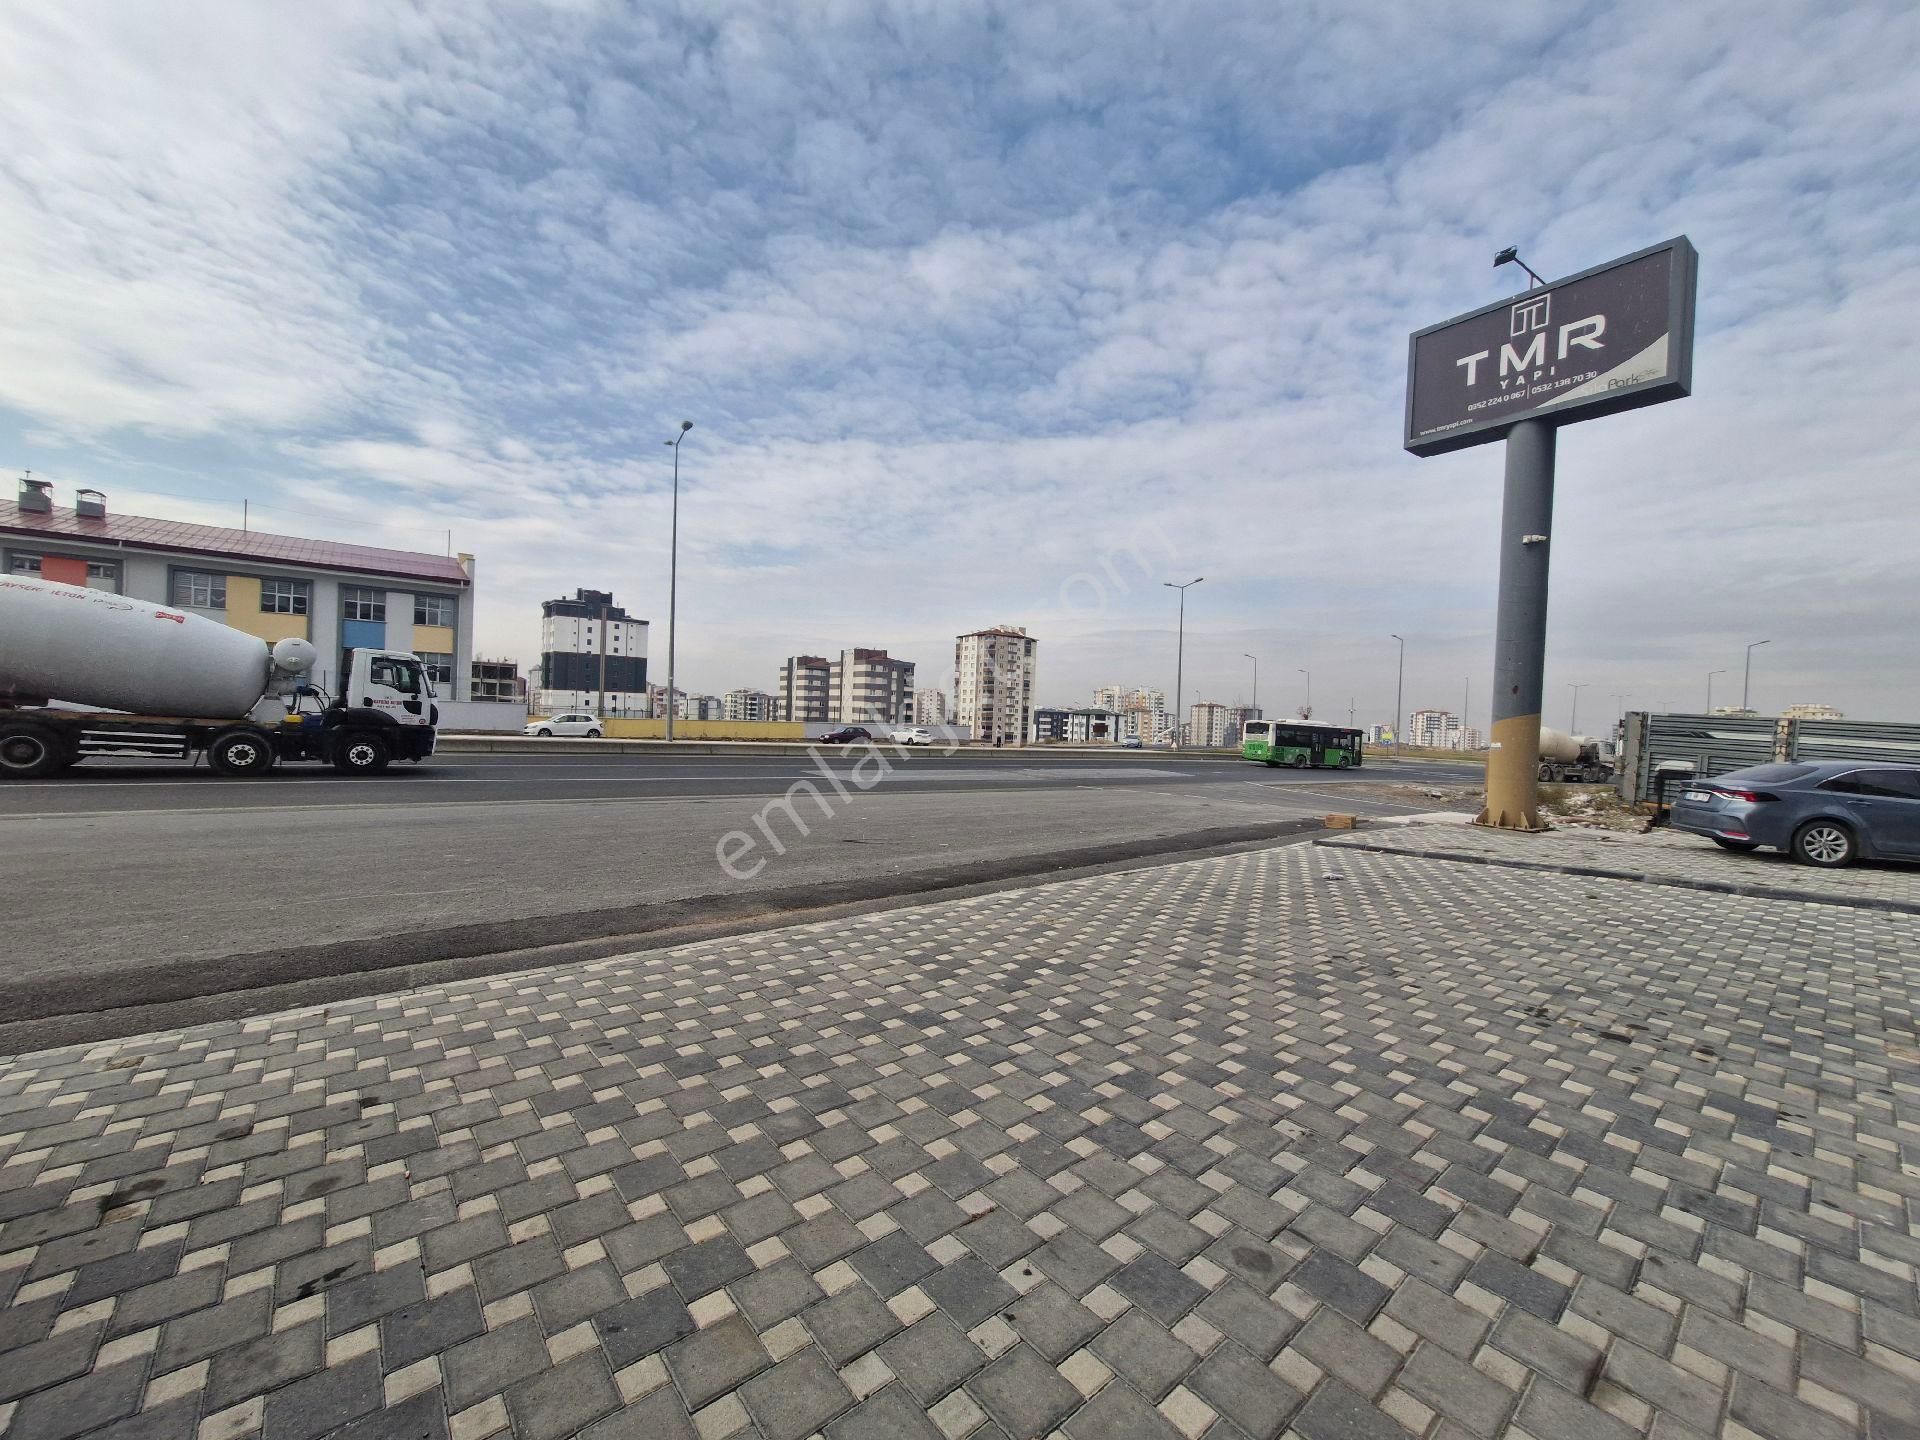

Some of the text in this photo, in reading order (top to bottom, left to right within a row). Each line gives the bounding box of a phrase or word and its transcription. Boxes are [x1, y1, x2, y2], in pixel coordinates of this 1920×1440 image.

[1456, 314, 1606, 386] TMR
[1487, 396, 1502, 406] 224
[1531, 383, 1552, 394] 0532
[1572, 373, 1584, 384] 70
[1585, 370, 1598, 380] 30
[1500, 366, 1555, 390] YAPI
